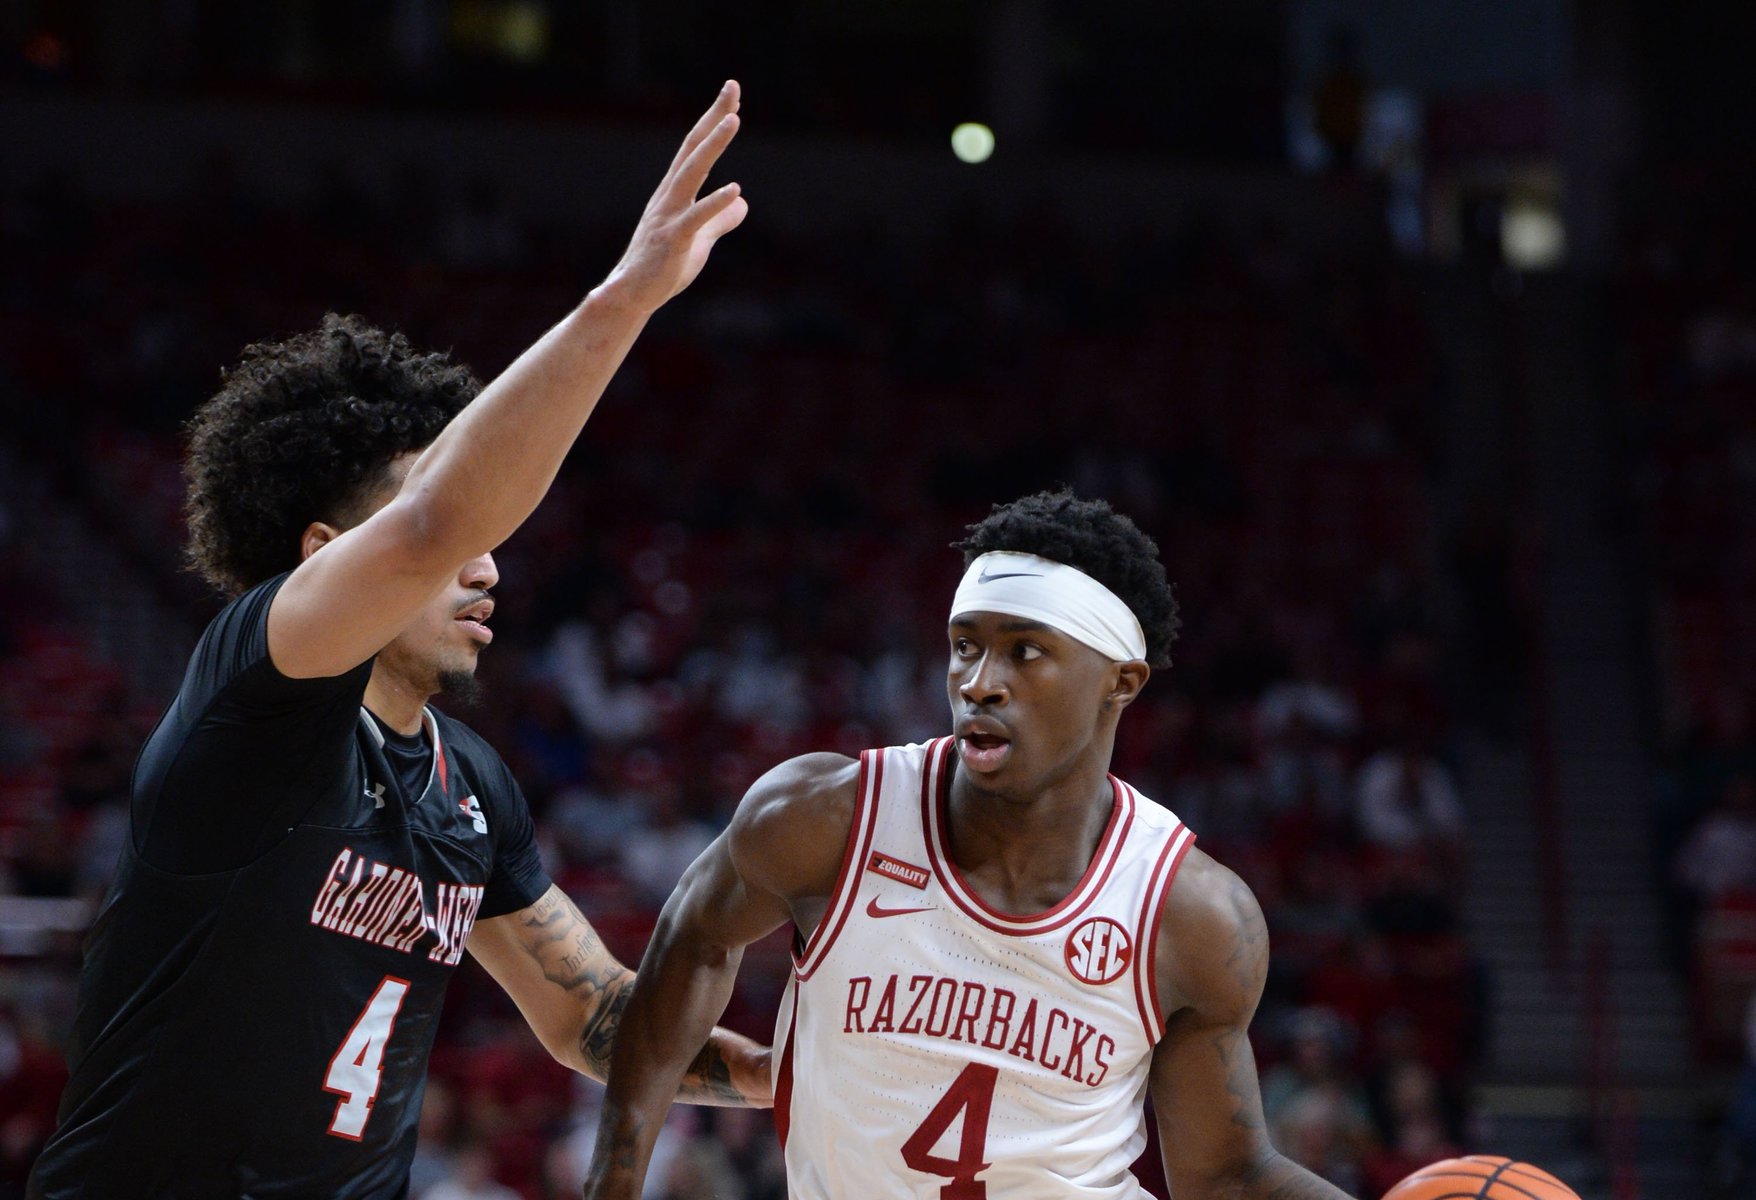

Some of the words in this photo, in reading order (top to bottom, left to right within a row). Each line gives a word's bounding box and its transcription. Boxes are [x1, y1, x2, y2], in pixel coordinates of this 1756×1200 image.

[878, 859, 927, 884] EQUALITY
[1070, 920, 1129, 981] SEC
[322, 974, 411, 1142] 4
[843, 974, 1116, 1088] RAZORBACKS
